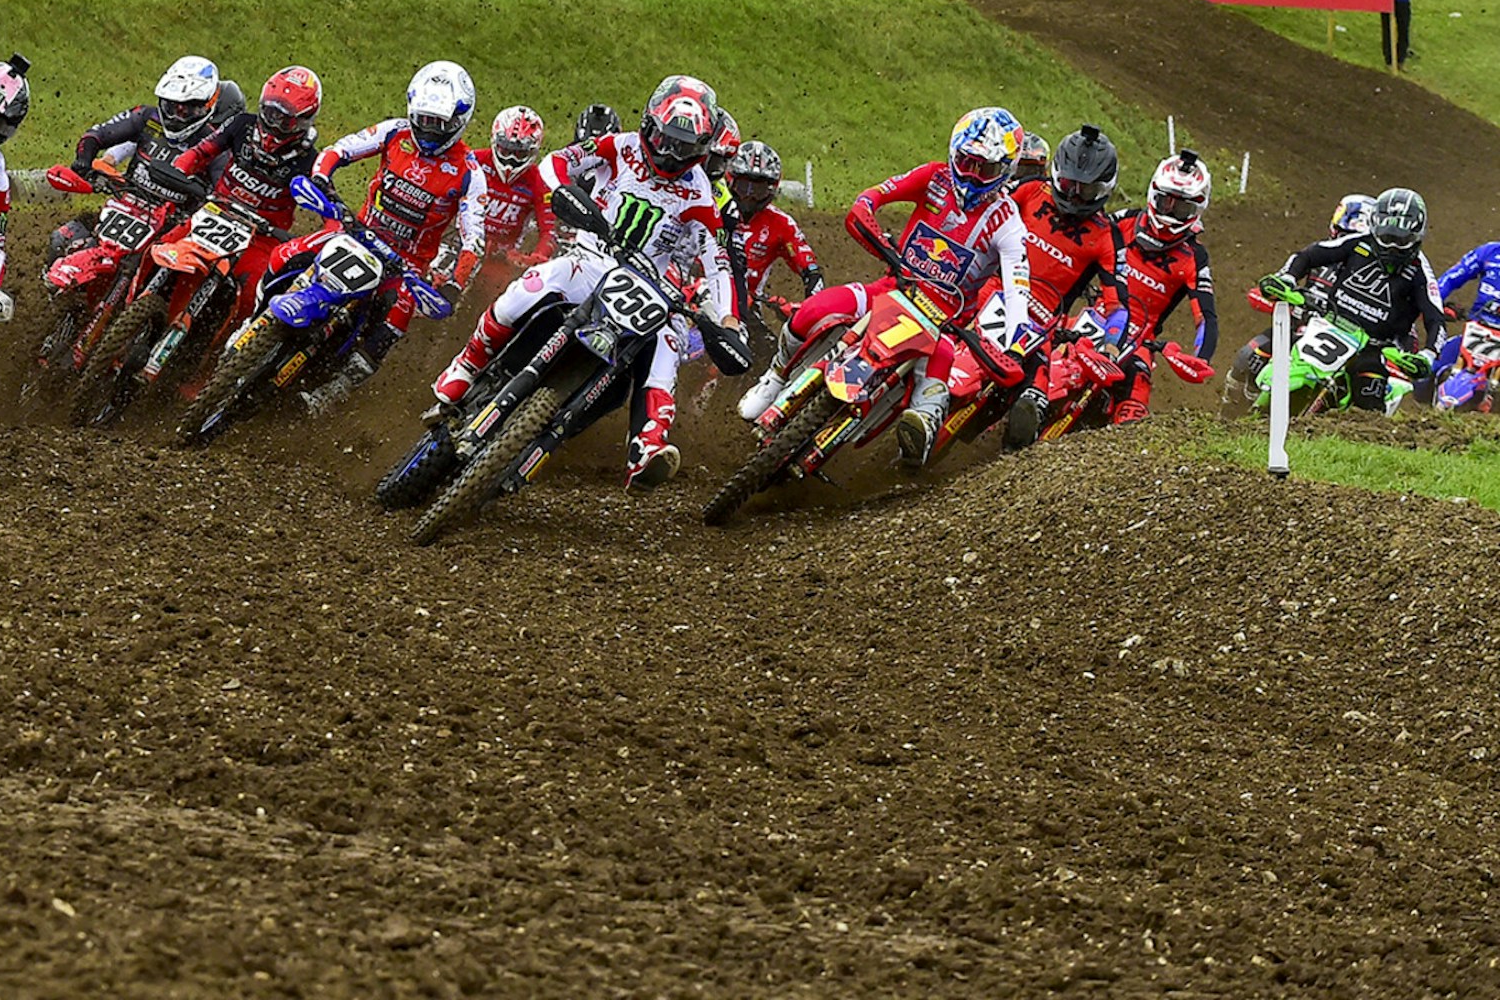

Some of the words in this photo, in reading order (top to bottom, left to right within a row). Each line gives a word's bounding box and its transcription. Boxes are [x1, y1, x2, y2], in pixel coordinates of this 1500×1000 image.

[228, 163, 283, 200] KOSAK
[390, 188, 427, 210] RACING
[394, 178, 436, 205] GEBBEN
[649, 182, 703, 201] years
[97, 209, 152, 250] 189
[191, 217, 248, 252] 226
[972, 200, 1015, 255] THOR
[904, 247, 930, 271] Red
[928, 261, 959, 284] Bull
[1025, 231, 1074, 268] ONDA
[319, 245, 378, 292] 10
[1123, 263, 1167, 294] ONDA
[599, 273, 667, 334] 259
[1334, 288, 1389, 322] Kawasaki
[876, 313, 923, 349] 1
[1077, 351, 1107, 382] ACERBIS
[1167, 354, 1198, 379] ACERBIS
[1301, 332, 1349, 366] 3
